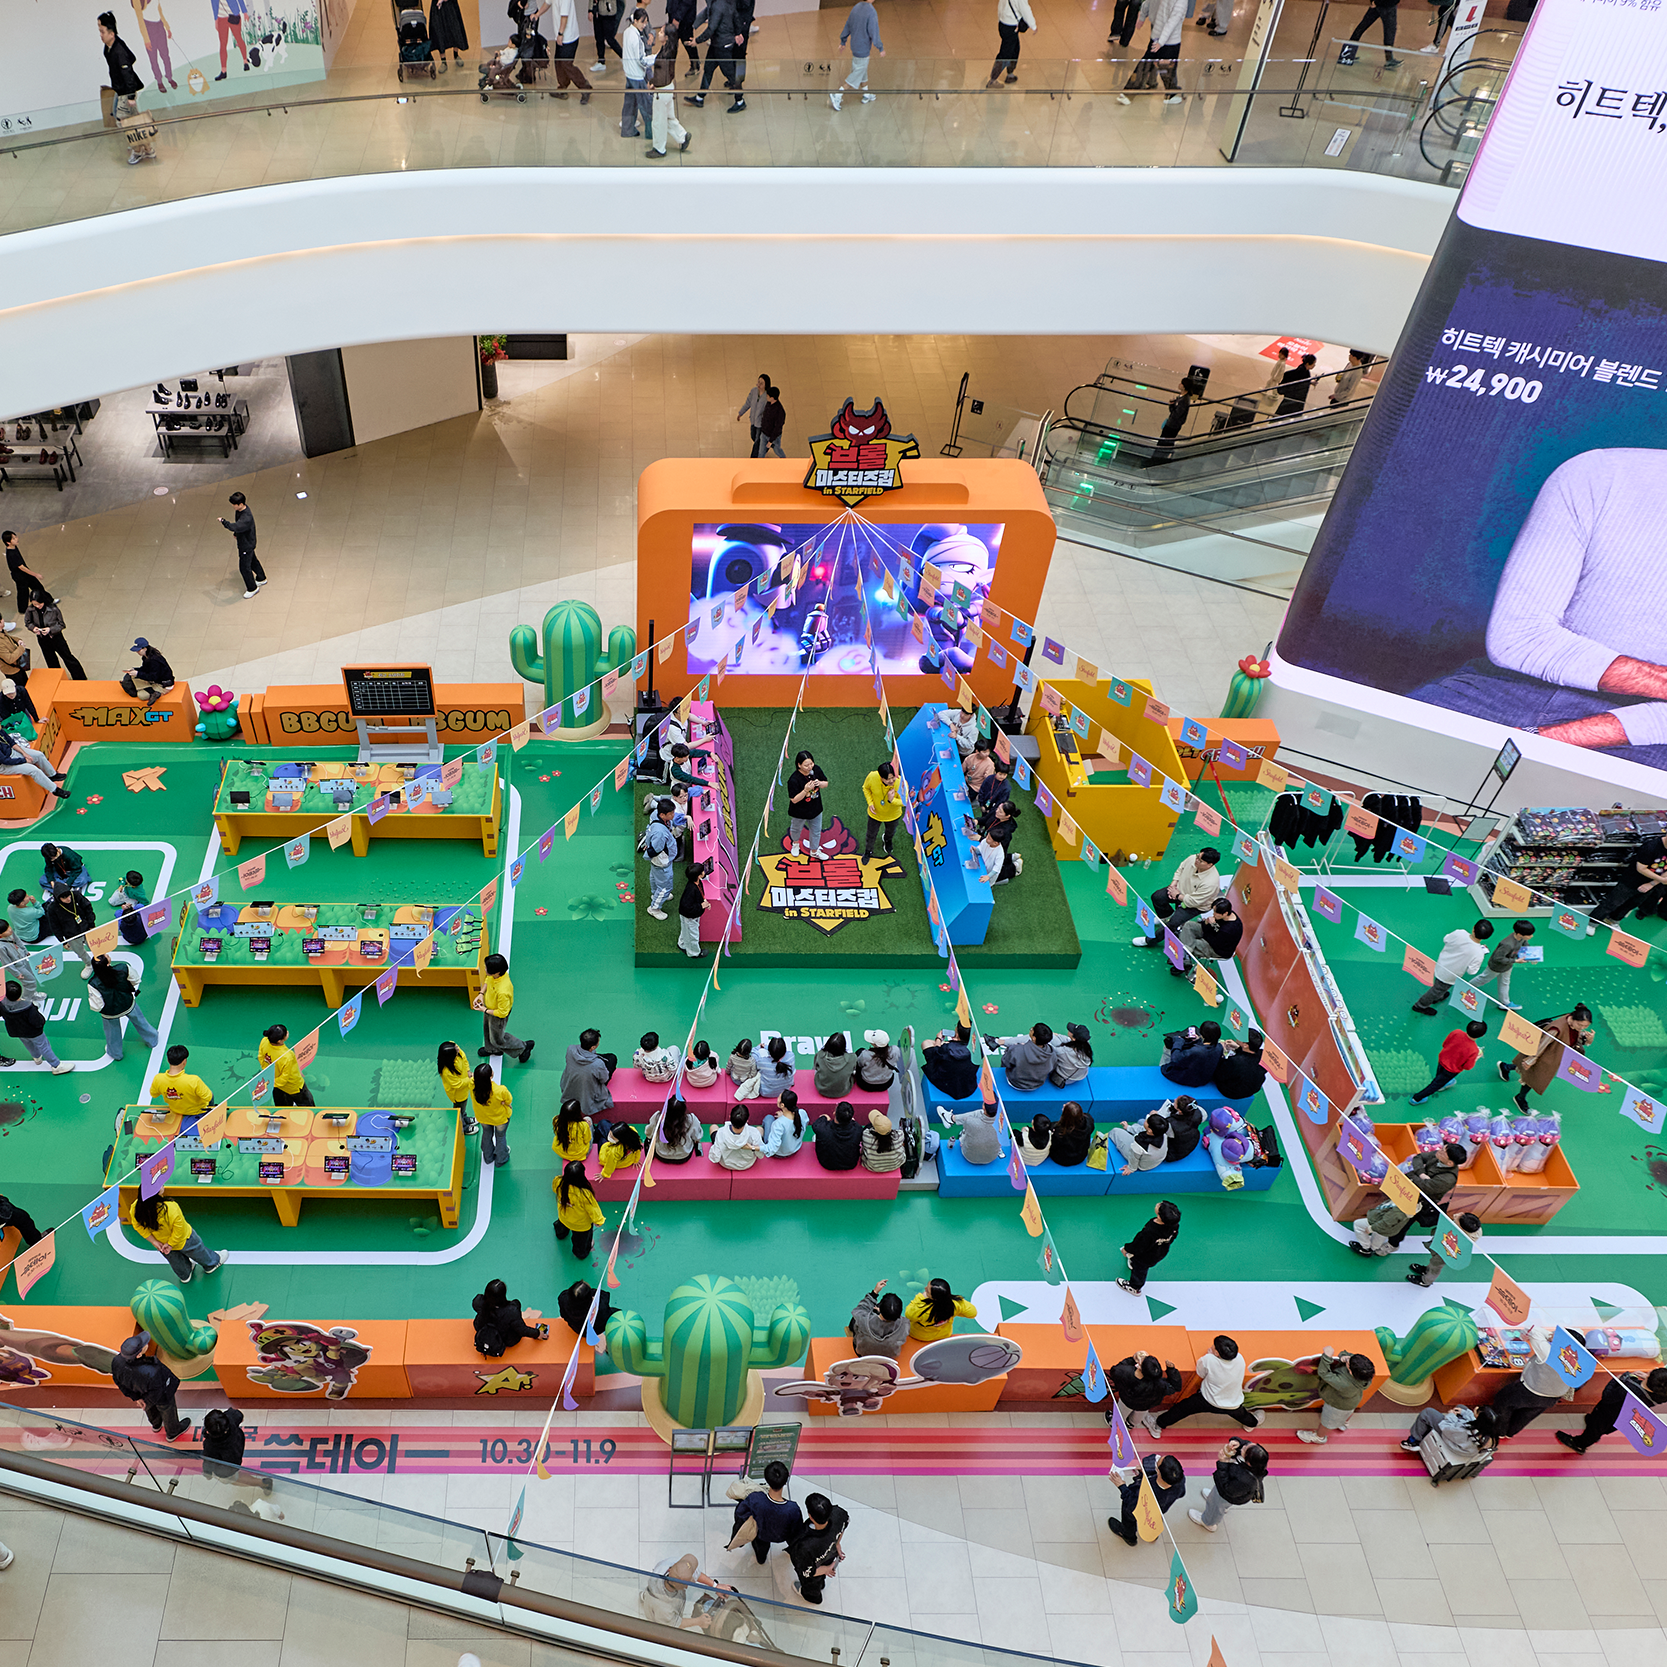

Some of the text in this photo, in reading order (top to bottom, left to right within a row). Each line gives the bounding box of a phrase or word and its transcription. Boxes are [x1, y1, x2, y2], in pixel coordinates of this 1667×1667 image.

[1556, 79, 1667, 134] 히트텍,
[126, 128, 148, 143] NIKE
[1441, 327, 1663, 390] 히트텍 캐시미어 블렌드
[1425, 363, 1543, 404] ₩24,900
[815, 469, 895, 487] 마스터즈컵
[834, 486, 884, 495] STARFIELD
[770, 886, 880, 910] 마스터즈컵
[784, 907, 869, 919] in STARFIELD
